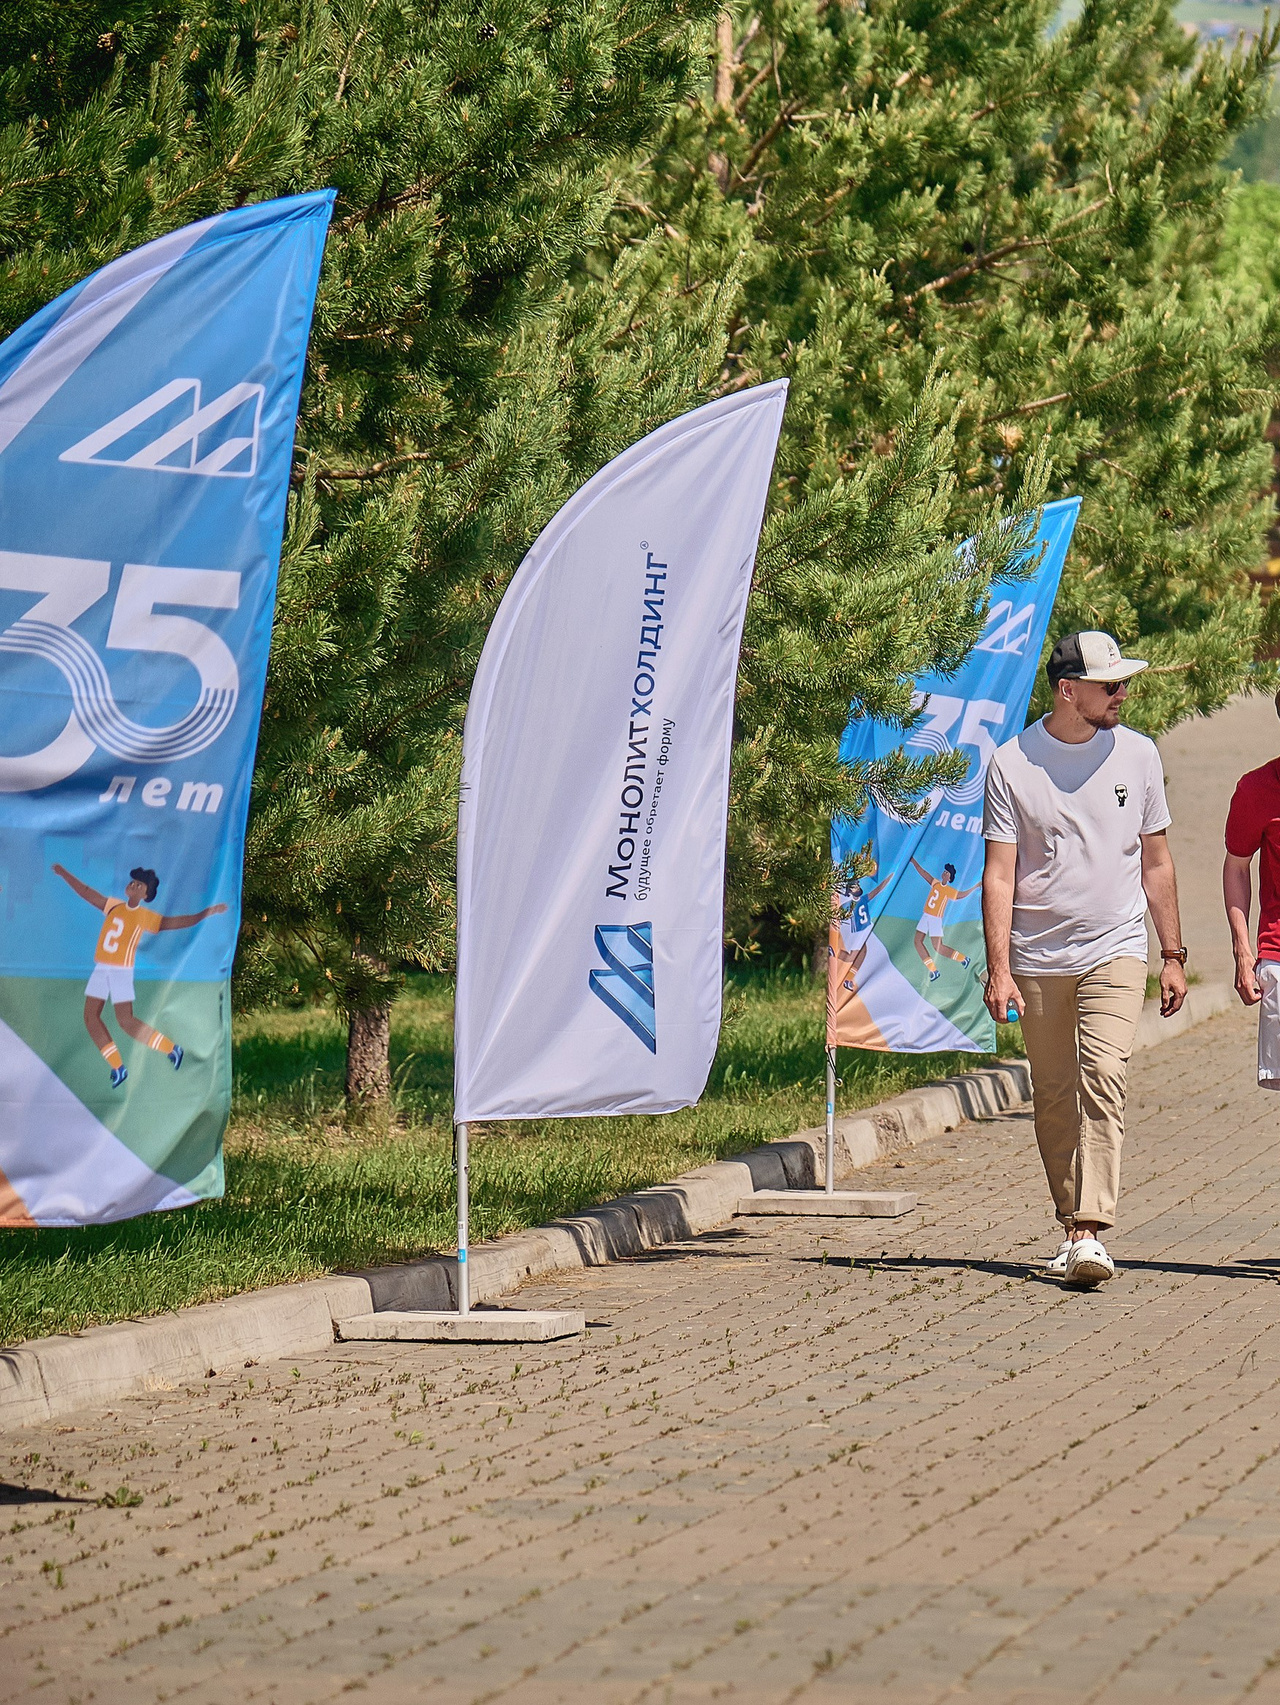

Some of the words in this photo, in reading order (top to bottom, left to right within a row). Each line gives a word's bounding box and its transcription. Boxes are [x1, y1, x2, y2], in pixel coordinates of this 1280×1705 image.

[0, 551, 241, 791] 35
[98, 775, 224, 813] лет
[633, 839, 652, 901] будущее
[646, 769, 665, 835] обретает
[656, 718, 675, 766] форму
[935, 810, 983, 834] лет
[928, 889, 940, 909] 2
[103, 917, 124, 953] 2
